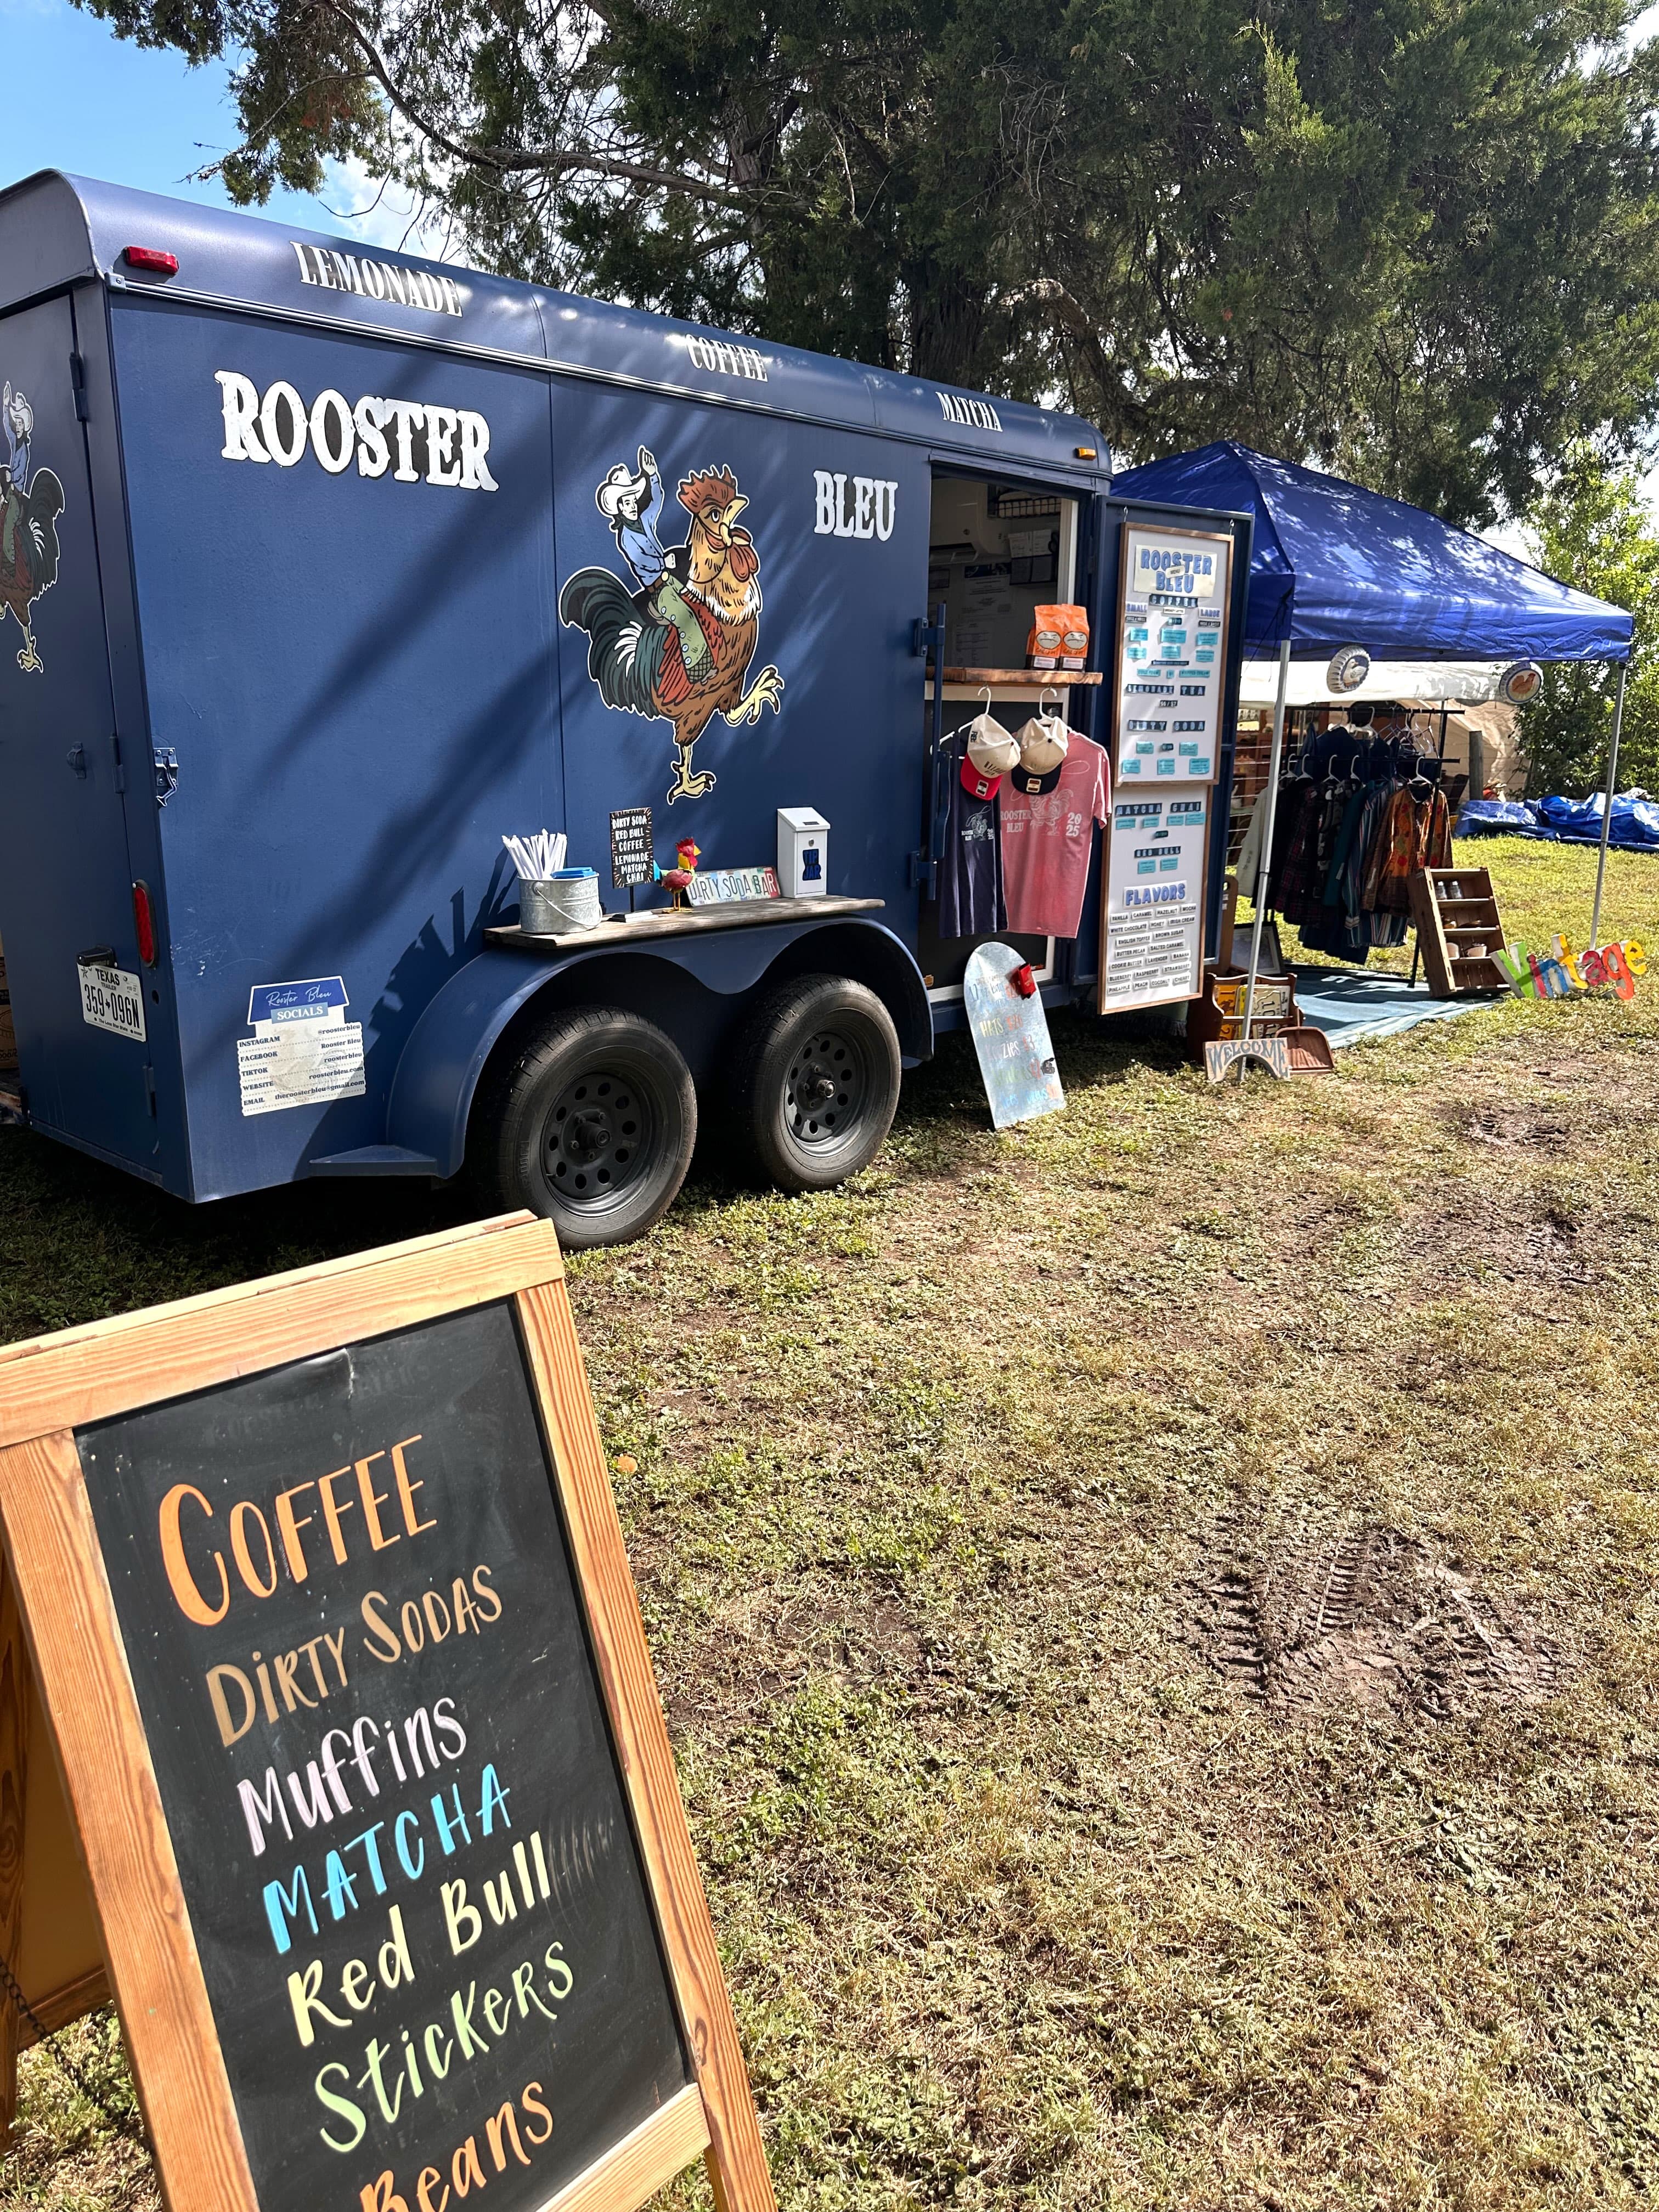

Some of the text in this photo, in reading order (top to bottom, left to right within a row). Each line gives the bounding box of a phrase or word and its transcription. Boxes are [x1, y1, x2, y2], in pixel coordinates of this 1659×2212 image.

[290, 241, 462, 318] LEMONADE
[685, 333, 768, 382] COFFEE
[935, 392, 1003, 432] MATCHA
[214, 369, 898, 541] ROOSTER BLEU
[1141, 549, 1212, 575] ROOSTER
[1155, 571, 1194, 594] BLEU
[1126, 603, 1147, 613] SMALL
[1150, 595, 1197, 607] COFFEE
[1200, 609, 1220, 618] LARGE
[1181, 687, 1203, 695] TEA
[1129, 720, 1204, 730] DIRTY SODA
[1116, 802, 1200, 815] MATCHA CHAI
[612, 815, 647, 830] DIRTY SODA
[1067, 812, 1082, 824] 20
[615, 827, 644, 841] RED BULL
[1065, 825, 1080, 837] 25
[618, 839, 644, 852] COFFEE
[615, 852, 650, 865] LEMONADE
[804, 850, 818, 865] TIP
[620, 862, 647, 874] MATCHA
[804, 865, 820, 879] JAR
[627, 872, 644, 883] CHAI
[689, 873, 777, 900] DIRTY SODA BAR
[1126, 883, 1186, 906] FLAVORS
[1164, 964, 1190, 972] STRAWBERRY
[1489, 933, 1647, 1000] Vintage
[95, 968, 120, 986] TEXAS
[100, 982, 117, 991] TRAILER
[266, 985, 332, 1006] Rooster Bleu
[84, 984, 140, 1029] 359 096N
[277, 1006, 323, 1020] SOCIALS
[318, 1024, 360, 1034] @roosterbleu
[239, 1036, 280, 1047] INSTAGRAM
[321, 1041, 346, 1049] Rooster
[240, 1051, 278, 1062] FACEBOOK
[324, 1052, 362, 1063] roosterbleu
[1207, 1039, 1289, 1079] WELCOME
[241, 1067, 268, 1076] TIKTOK
[309, 1066, 364, 1080] roosterbleu.com
[242, 1081, 274, 1091] WEBSITE
[275, 1080, 364, 1100] theroosterbleu@gmail.com
[244, 1097, 265, 1105] EMAIL
[159, 1434, 437, 1627] COFFEE
[360, 1565, 502, 1663] SODAS
[237, 1697, 467, 1857] Muffins
[263, 1763, 510, 1954] MATCHA
[287, 1831, 551, 2047] Red Bull
[359, 2081, 554, 2212] Beans
